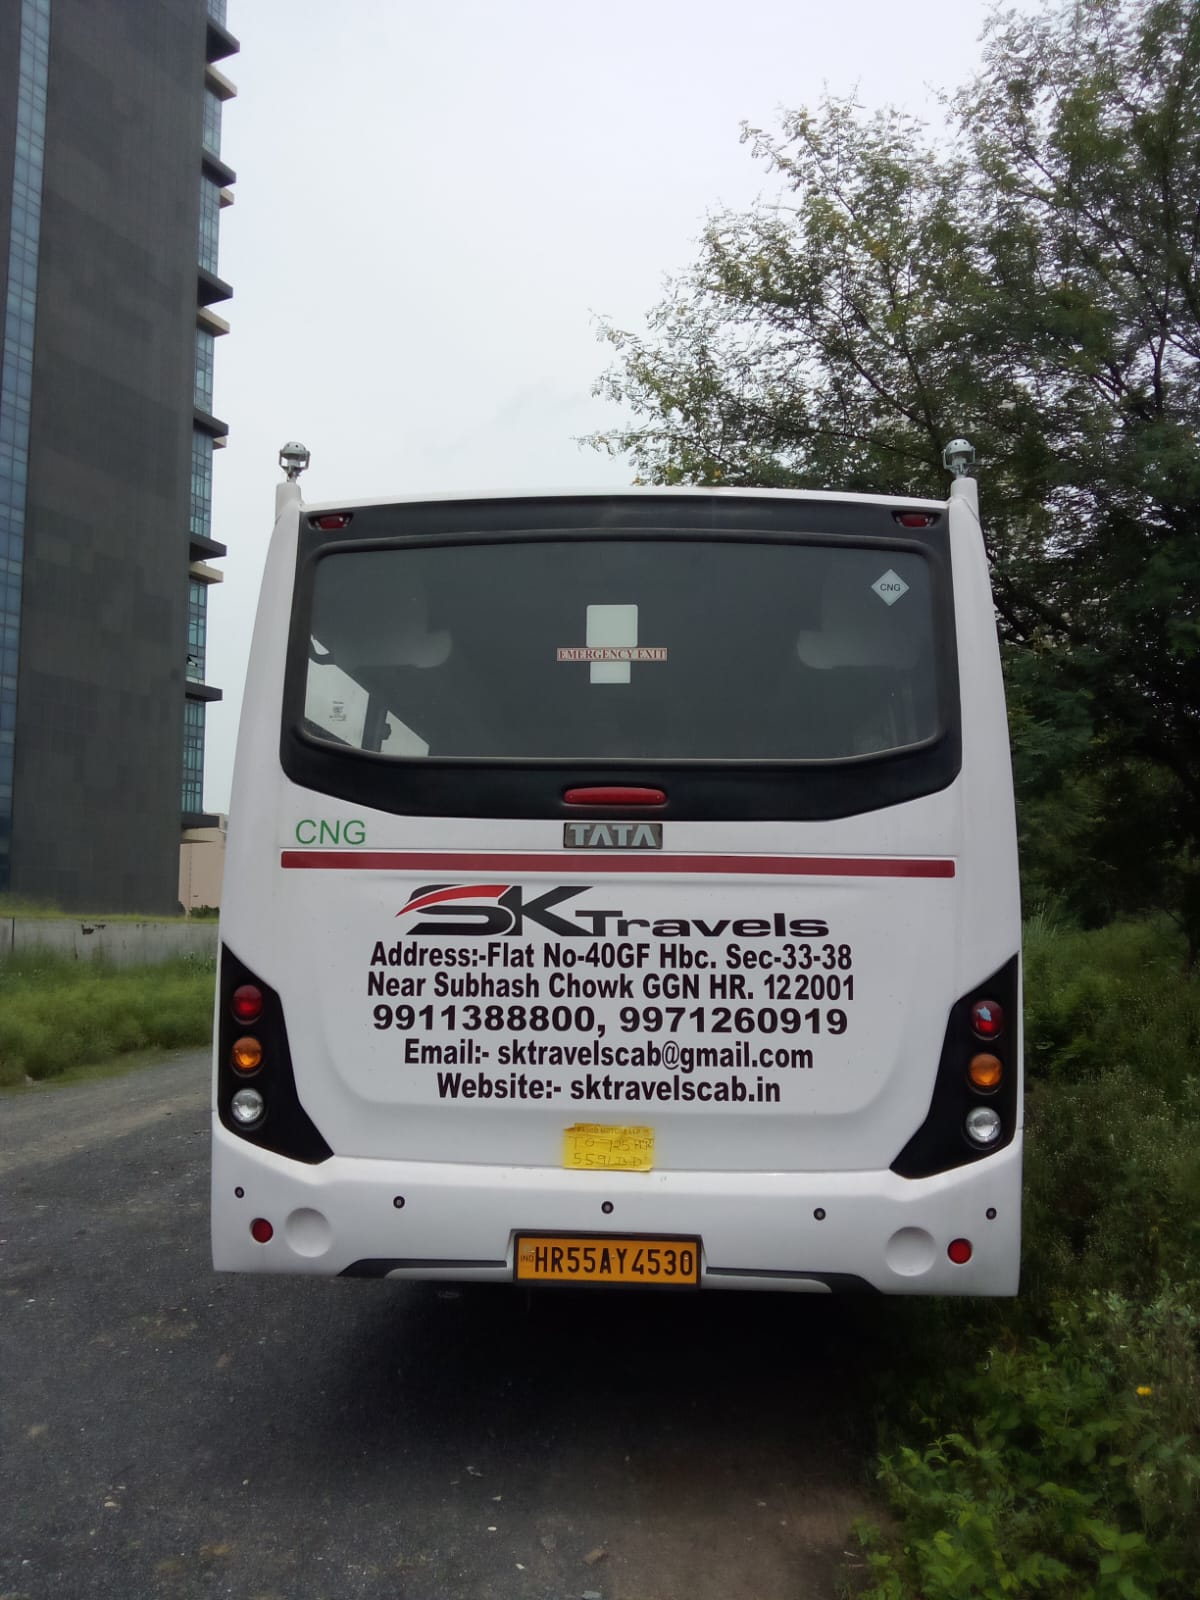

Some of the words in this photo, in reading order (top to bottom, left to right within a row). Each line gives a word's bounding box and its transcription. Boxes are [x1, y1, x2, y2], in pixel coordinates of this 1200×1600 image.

[880, 583, 901, 592] CNG
[559, 649, 633, 659] EMERGENCY
[637, 649, 666, 659] EXIT
[295, 819, 366, 845] CNG
[569, 824, 657, 847] TATA
[543, 942, 651, 969] No-40GF
[659, 943, 717, 970] Hbc.
[725, 943, 853, 970] Sec-33-38
[367, 970, 427, 997] Near
[433, 971, 540, 998] Subhash
[548, 971, 635, 999] Chowk
[642, 972, 700, 1000] GGN
[709, 973, 754, 1000] HR.
[763, 973, 855, 1001] 122001
[372, 1003, 606, 1038] 9911388800,
[619, 1006, 848, 1034] 9971260919
[404, 1037, 490, 1065] Email:-
[497, 1038, 814, 1074] sktravelscab@gmail.com
[437, 1071, 562, 1099] Website:-
[570, 1073, 781, 1103] sktravelscab.in
[535, 1246, 693, 1277] HR55AY4530
